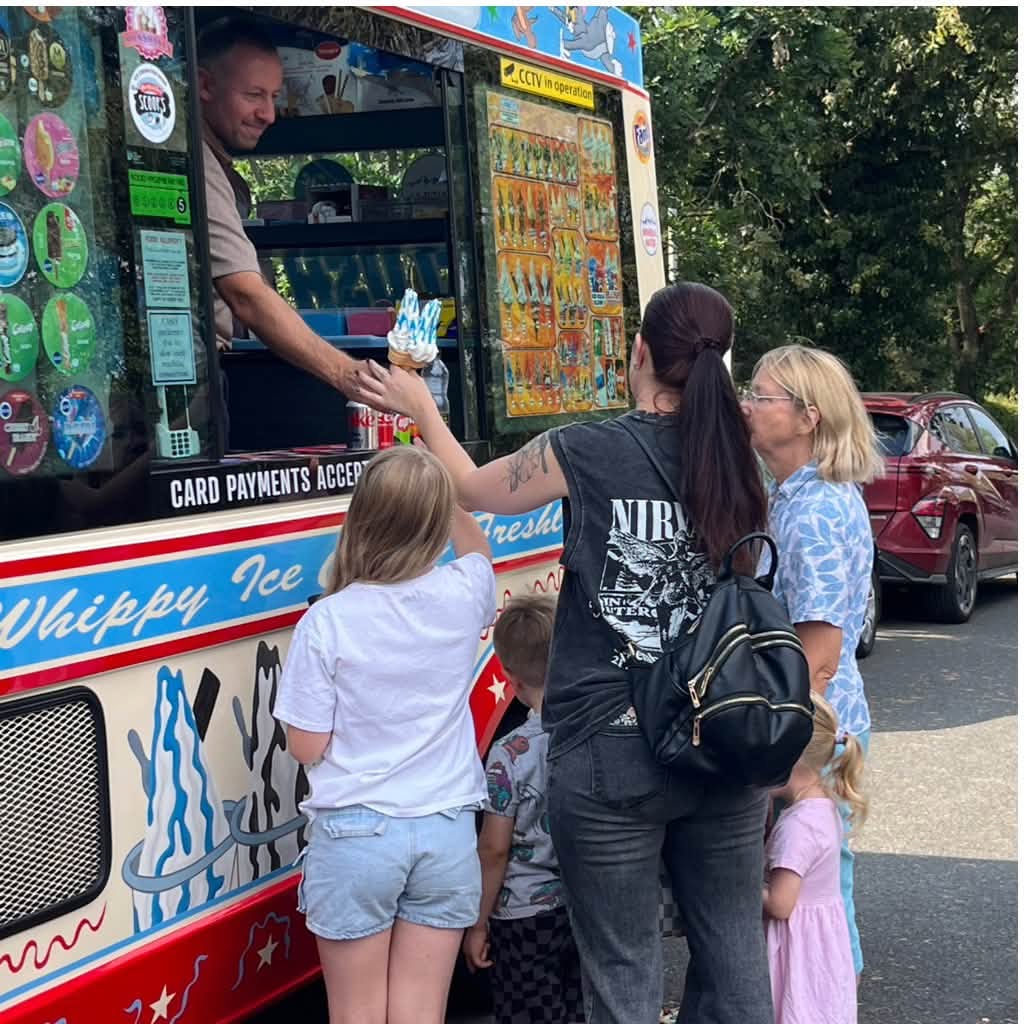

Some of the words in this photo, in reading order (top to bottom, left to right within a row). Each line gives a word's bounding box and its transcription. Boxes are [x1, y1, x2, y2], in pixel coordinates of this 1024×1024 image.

[519, 69, 543, 88] CCTV
[544, 76, 553, 88] in
[554, 80, 593, 101] operation
[170, 476, 220, 508] CARD
[226, 466, 311, 502] PAYMENTS
[317, 460, 369, 490] ACCEP
[610, 499, 690, 542] NIRV
[0, 583, 209, 649] Whippy
[231, 553, 303, 602] Ice
